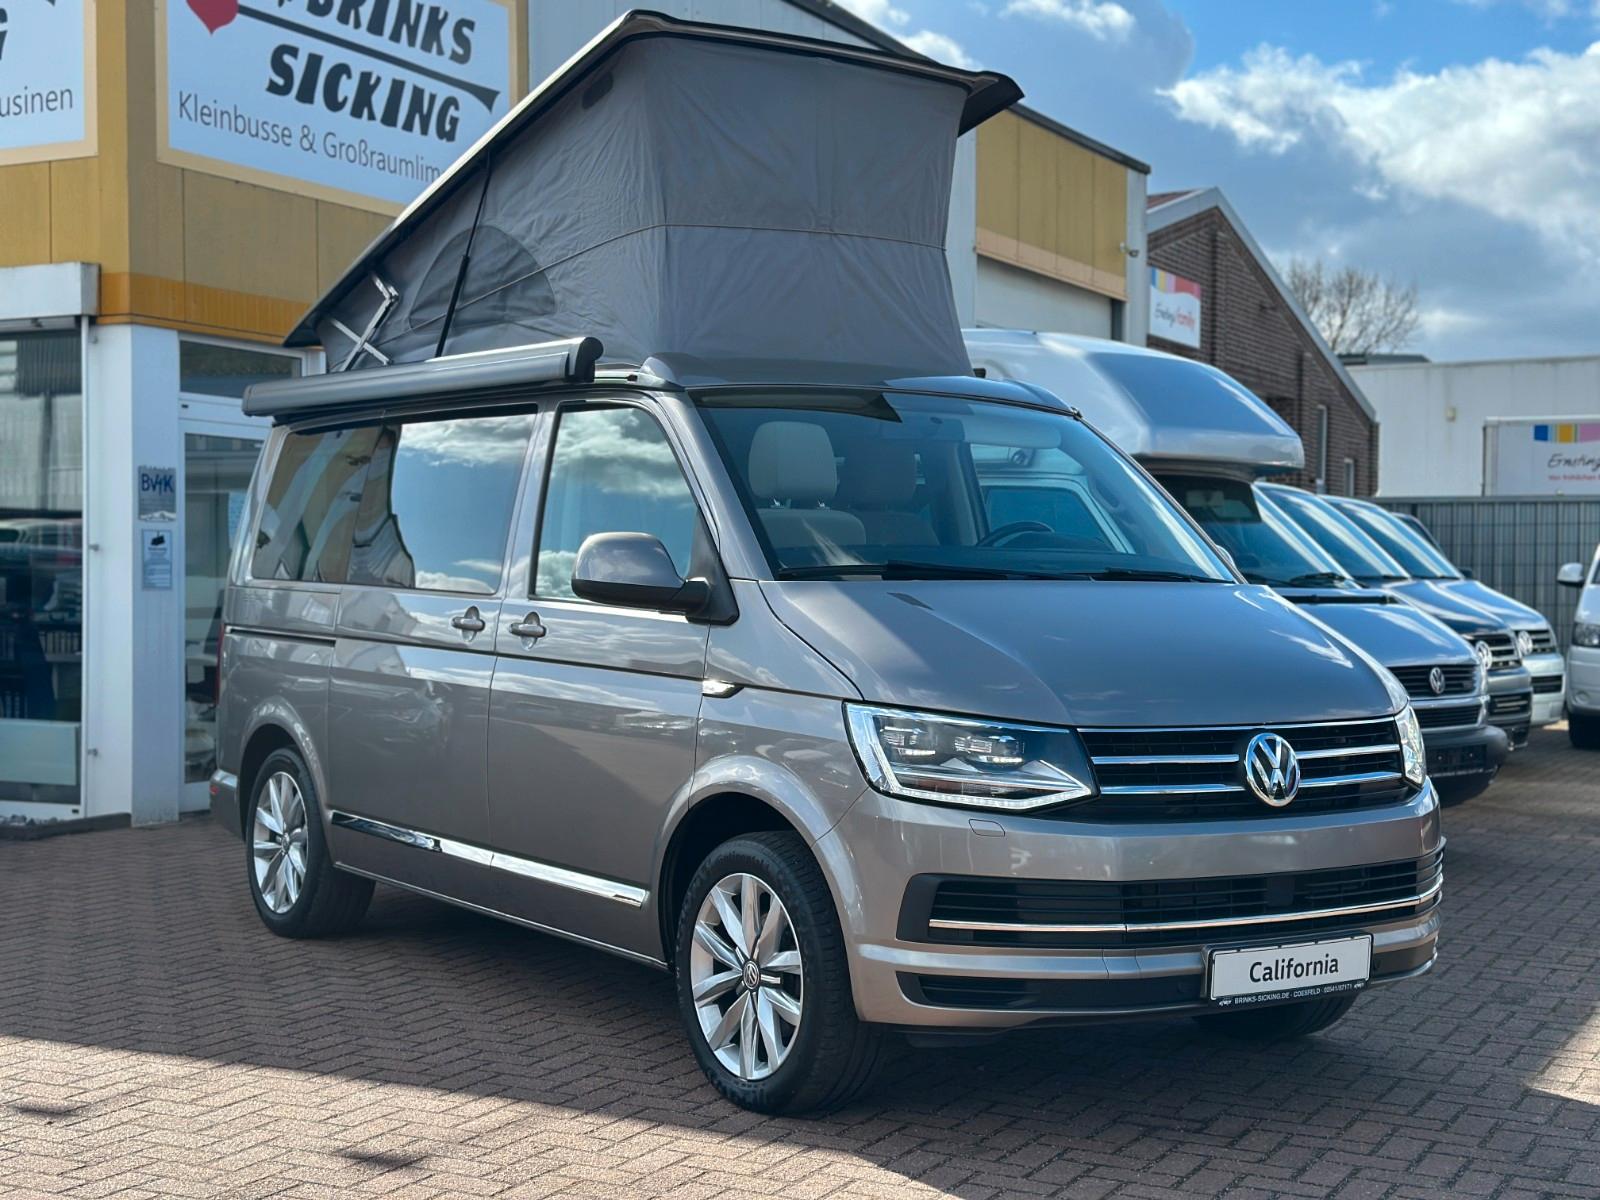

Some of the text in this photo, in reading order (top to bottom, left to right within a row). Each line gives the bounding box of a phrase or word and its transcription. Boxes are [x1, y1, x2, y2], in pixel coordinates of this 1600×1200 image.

[178, 90, 293, 147] Kleinbusse
[299, 124, 317, 154] &
[265, 43, 461, 142] SICKING
[1250, 954, 1339, 983] California
